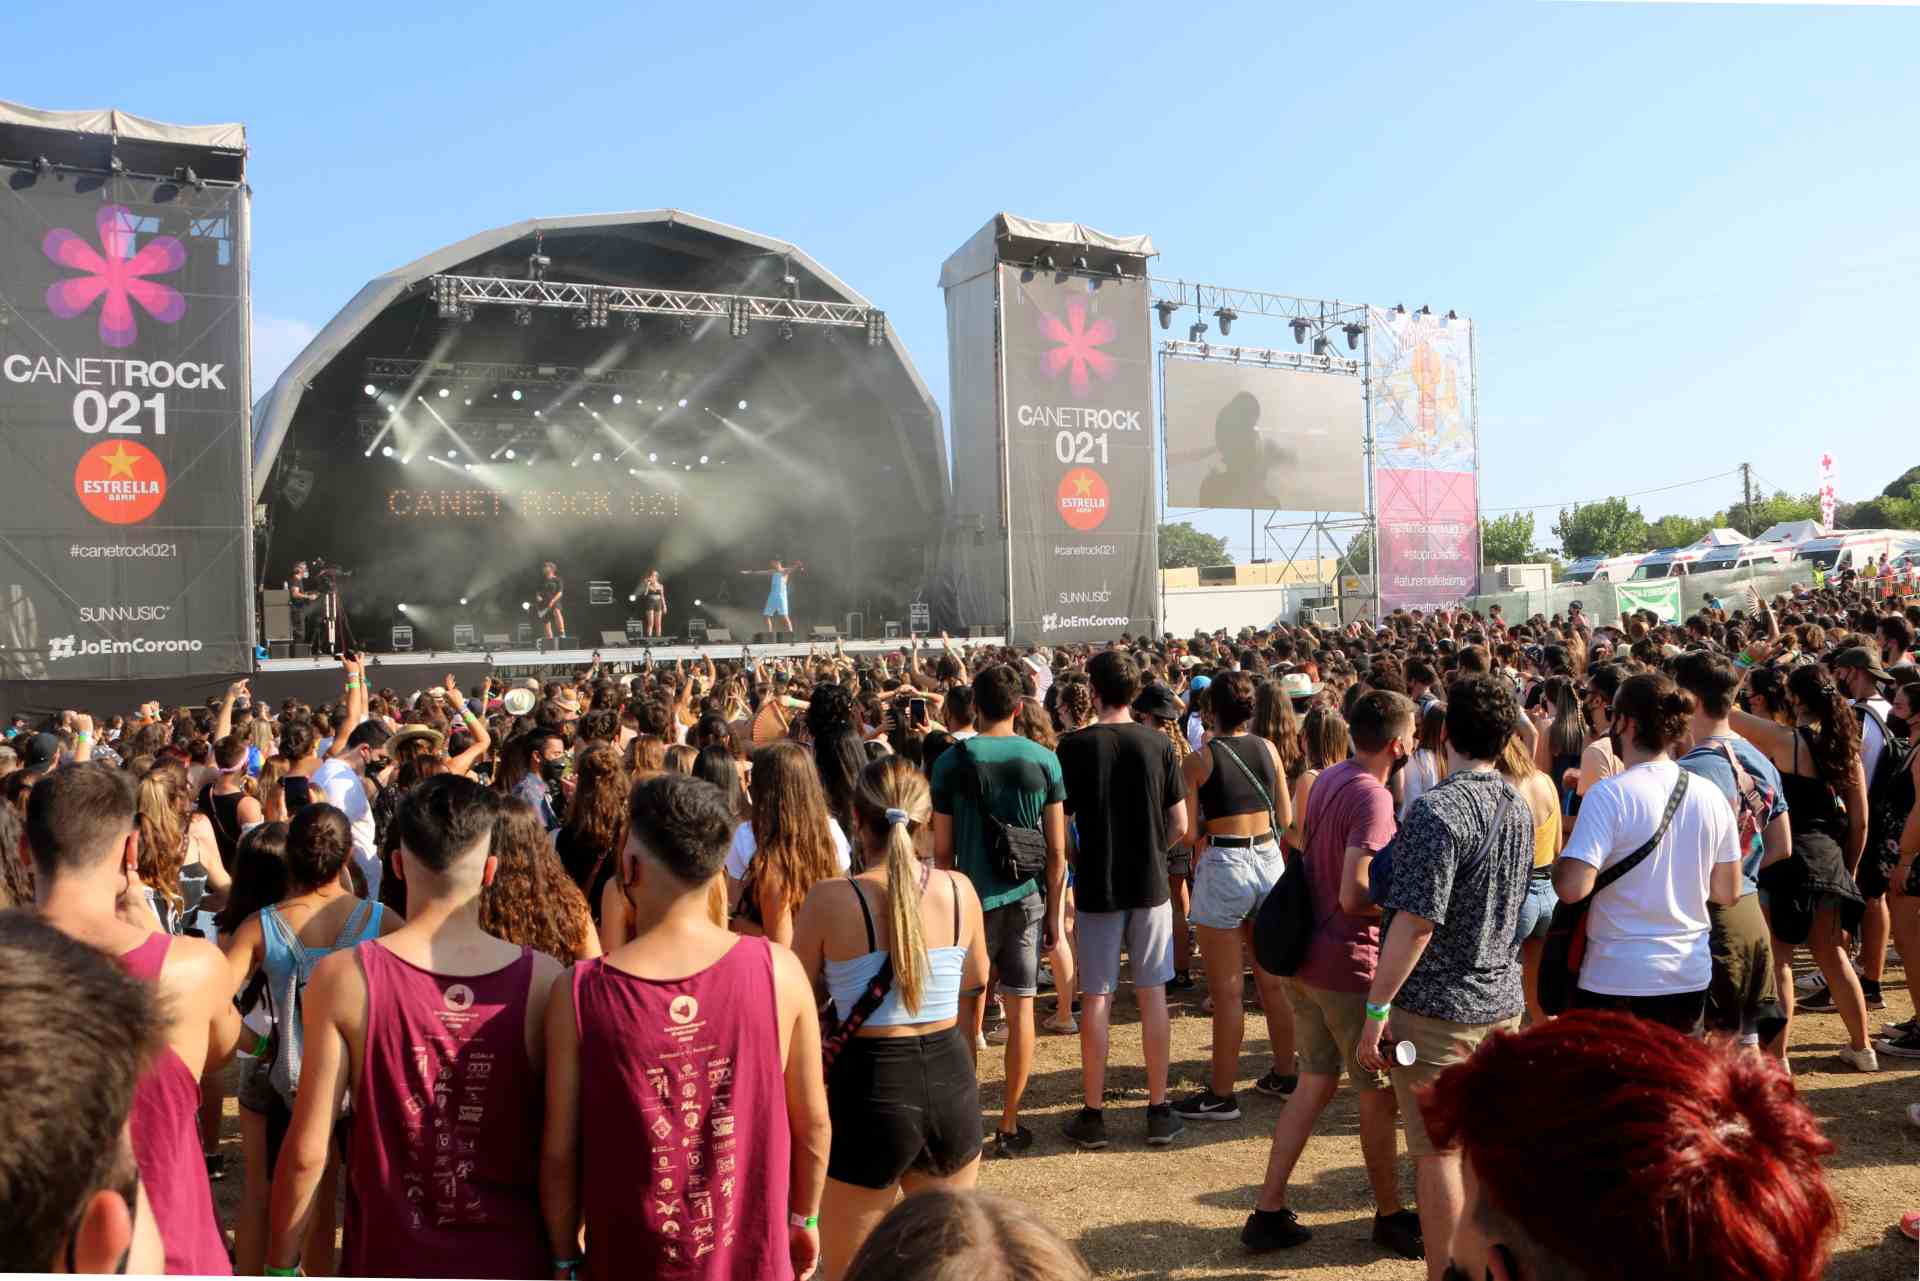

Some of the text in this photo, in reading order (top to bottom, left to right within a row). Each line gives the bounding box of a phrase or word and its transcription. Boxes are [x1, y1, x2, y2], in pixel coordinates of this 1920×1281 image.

[4, 354, 226, 390] CANETROCK
[73, 390, 166, 435] 021
[1018, 404, 1141, 431] CANETROCK
[1056, 430, 1109, 465] 021
[83, 480, 160, 494] ESTRELLA
[387, 489, 512, 516] CANET
[520, 489, 617, 516] ROCK
[70, 543, 177, 558] #canetrock021
